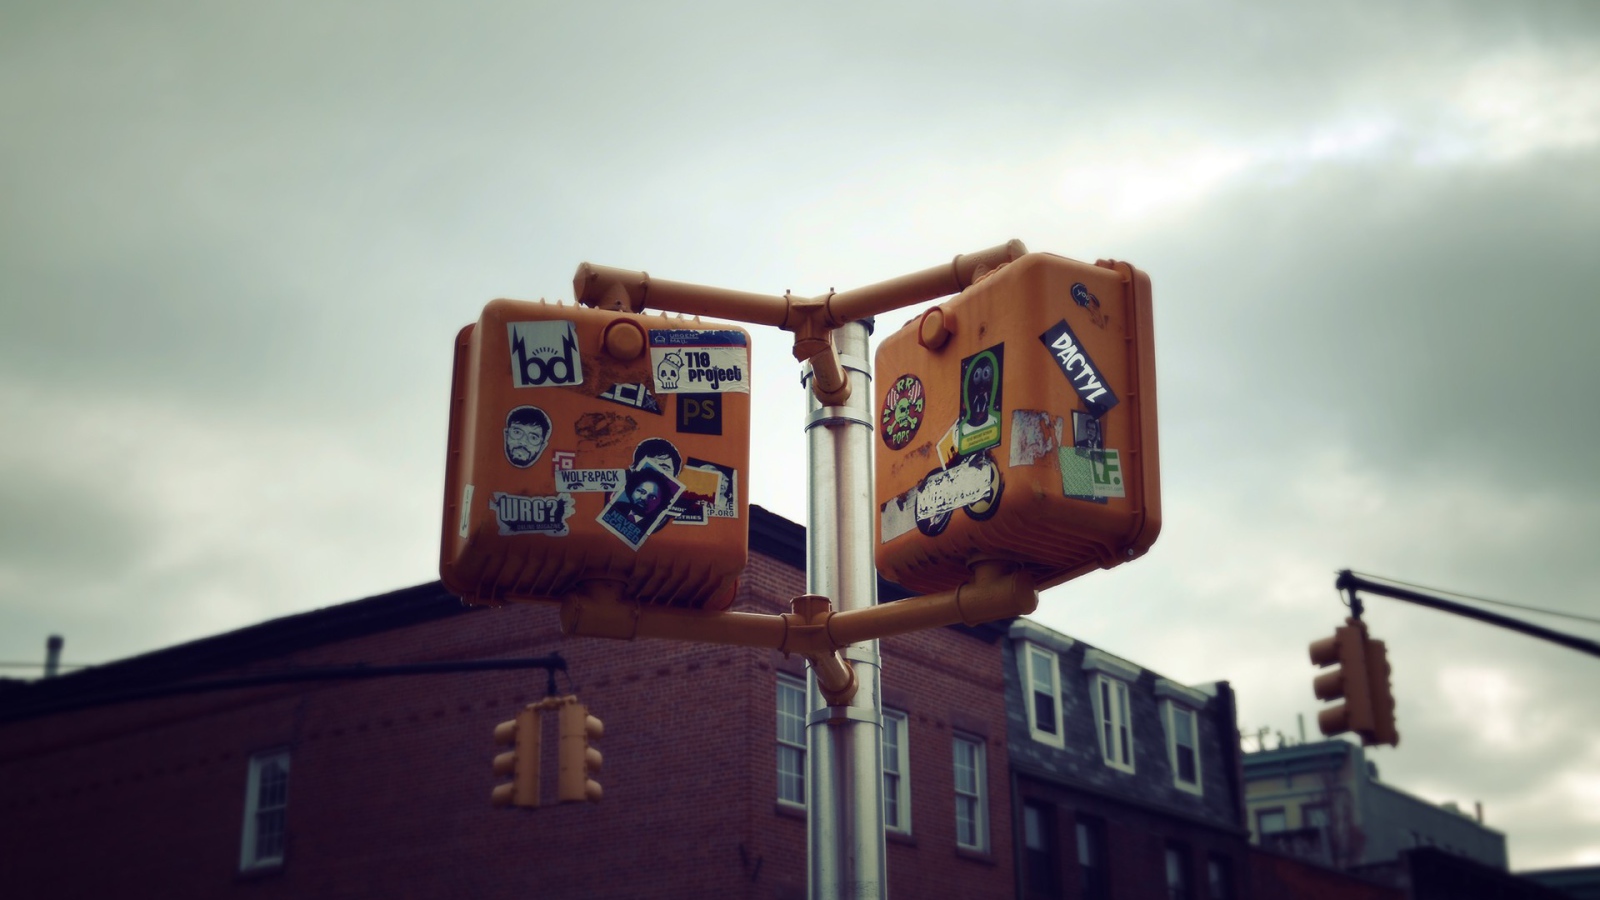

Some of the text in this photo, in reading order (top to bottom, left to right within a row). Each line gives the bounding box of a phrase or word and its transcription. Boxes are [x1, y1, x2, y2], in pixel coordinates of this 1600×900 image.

[512, 325, 578, 385] bd
[685, 351, 711, 367] 718
[1051, 332, 1108, 403] DACTYL
[688, 365, 742, 390] project
[683, 398, 715, 425] ps
[561, 470, 619, 483] WOLF&PACK
[499, 497, 558, 523] WRG?
[610, 510, 641, 535] NEVER
[603, 514, 640, 544] SCARED
